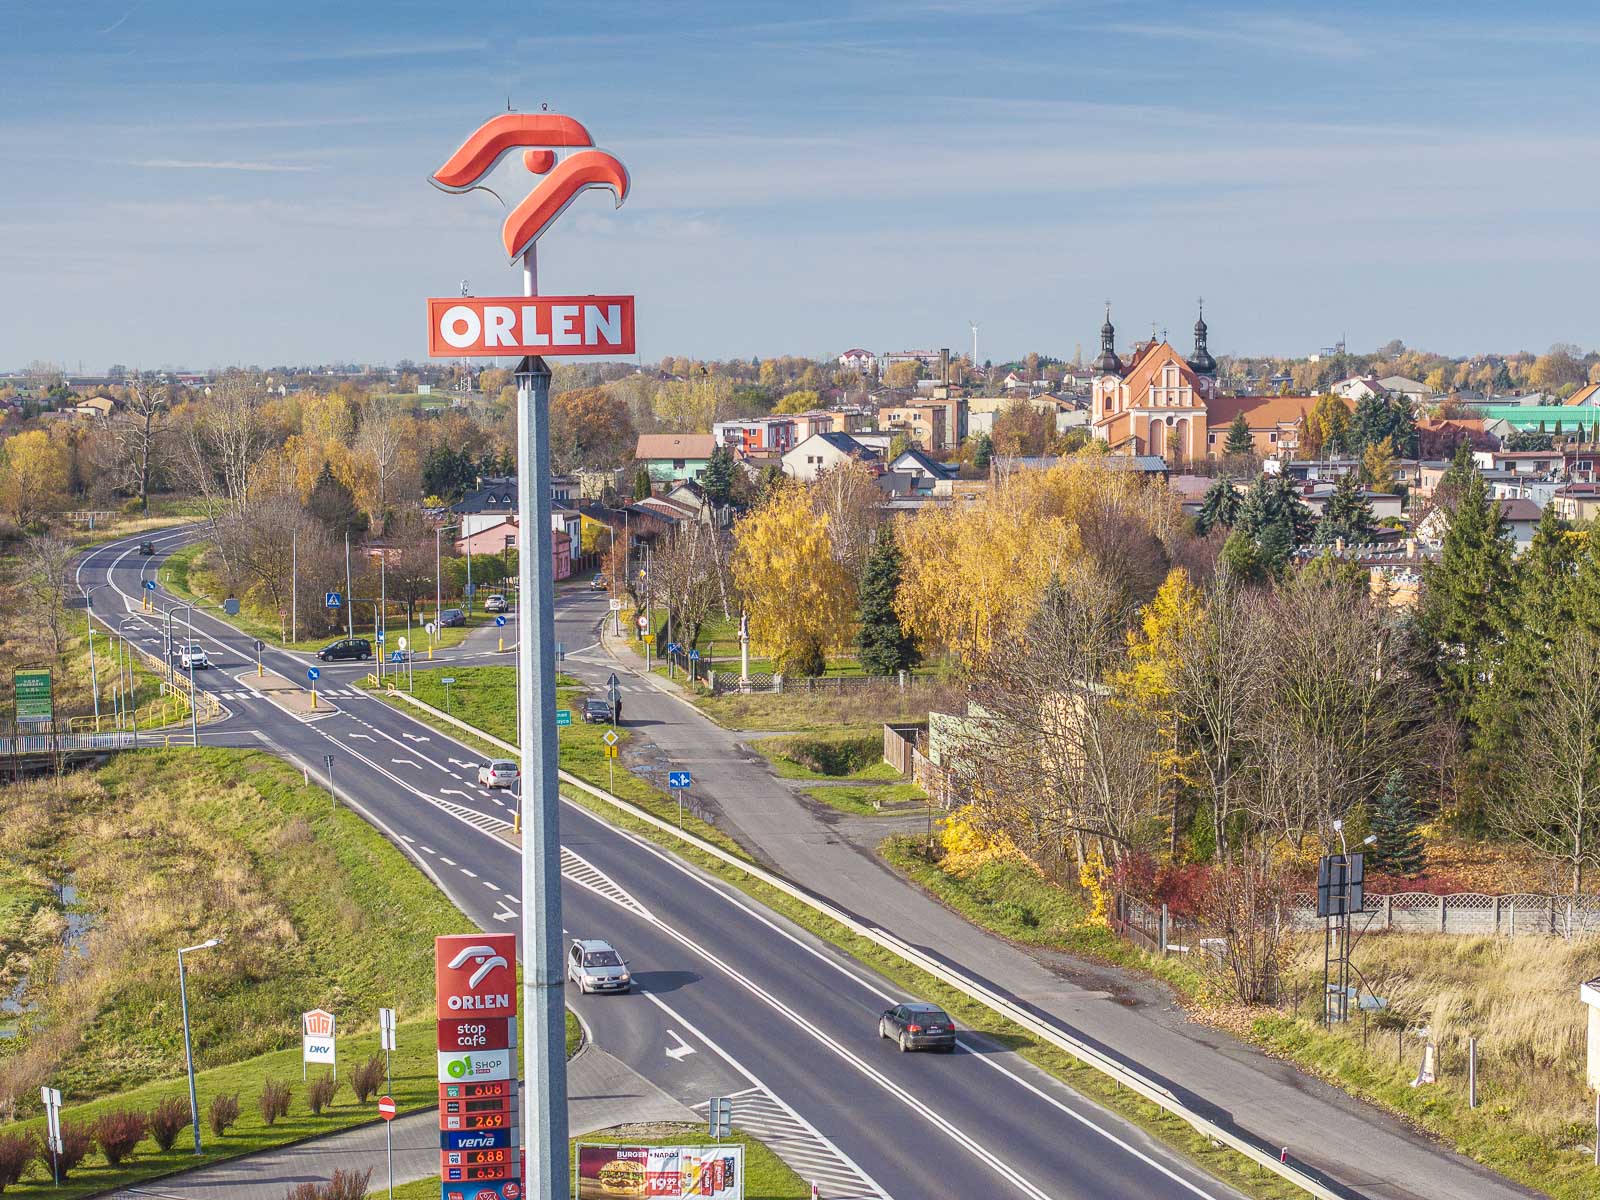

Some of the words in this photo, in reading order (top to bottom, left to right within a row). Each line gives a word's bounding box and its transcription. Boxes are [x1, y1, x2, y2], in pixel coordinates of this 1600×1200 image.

[440, 305, 622, 348] ORLEN
[448, 994, 509, 1010] ORLEN
[308, 1012, 330, 1033] UTA
[457, 1024, 486, 1036] stop
[458, 1035, 487, 1046] cafe
[448, 1056, 474, 1078] O!
[475, 1061, 502, 1069] SHOP
[476, 1115, 502, 1128] 2.69
[458, 1138, 495, 1147] verva
[477, 1150, 503, 1163] 6.88
[616, 1150, 648, 1159] BURGER
